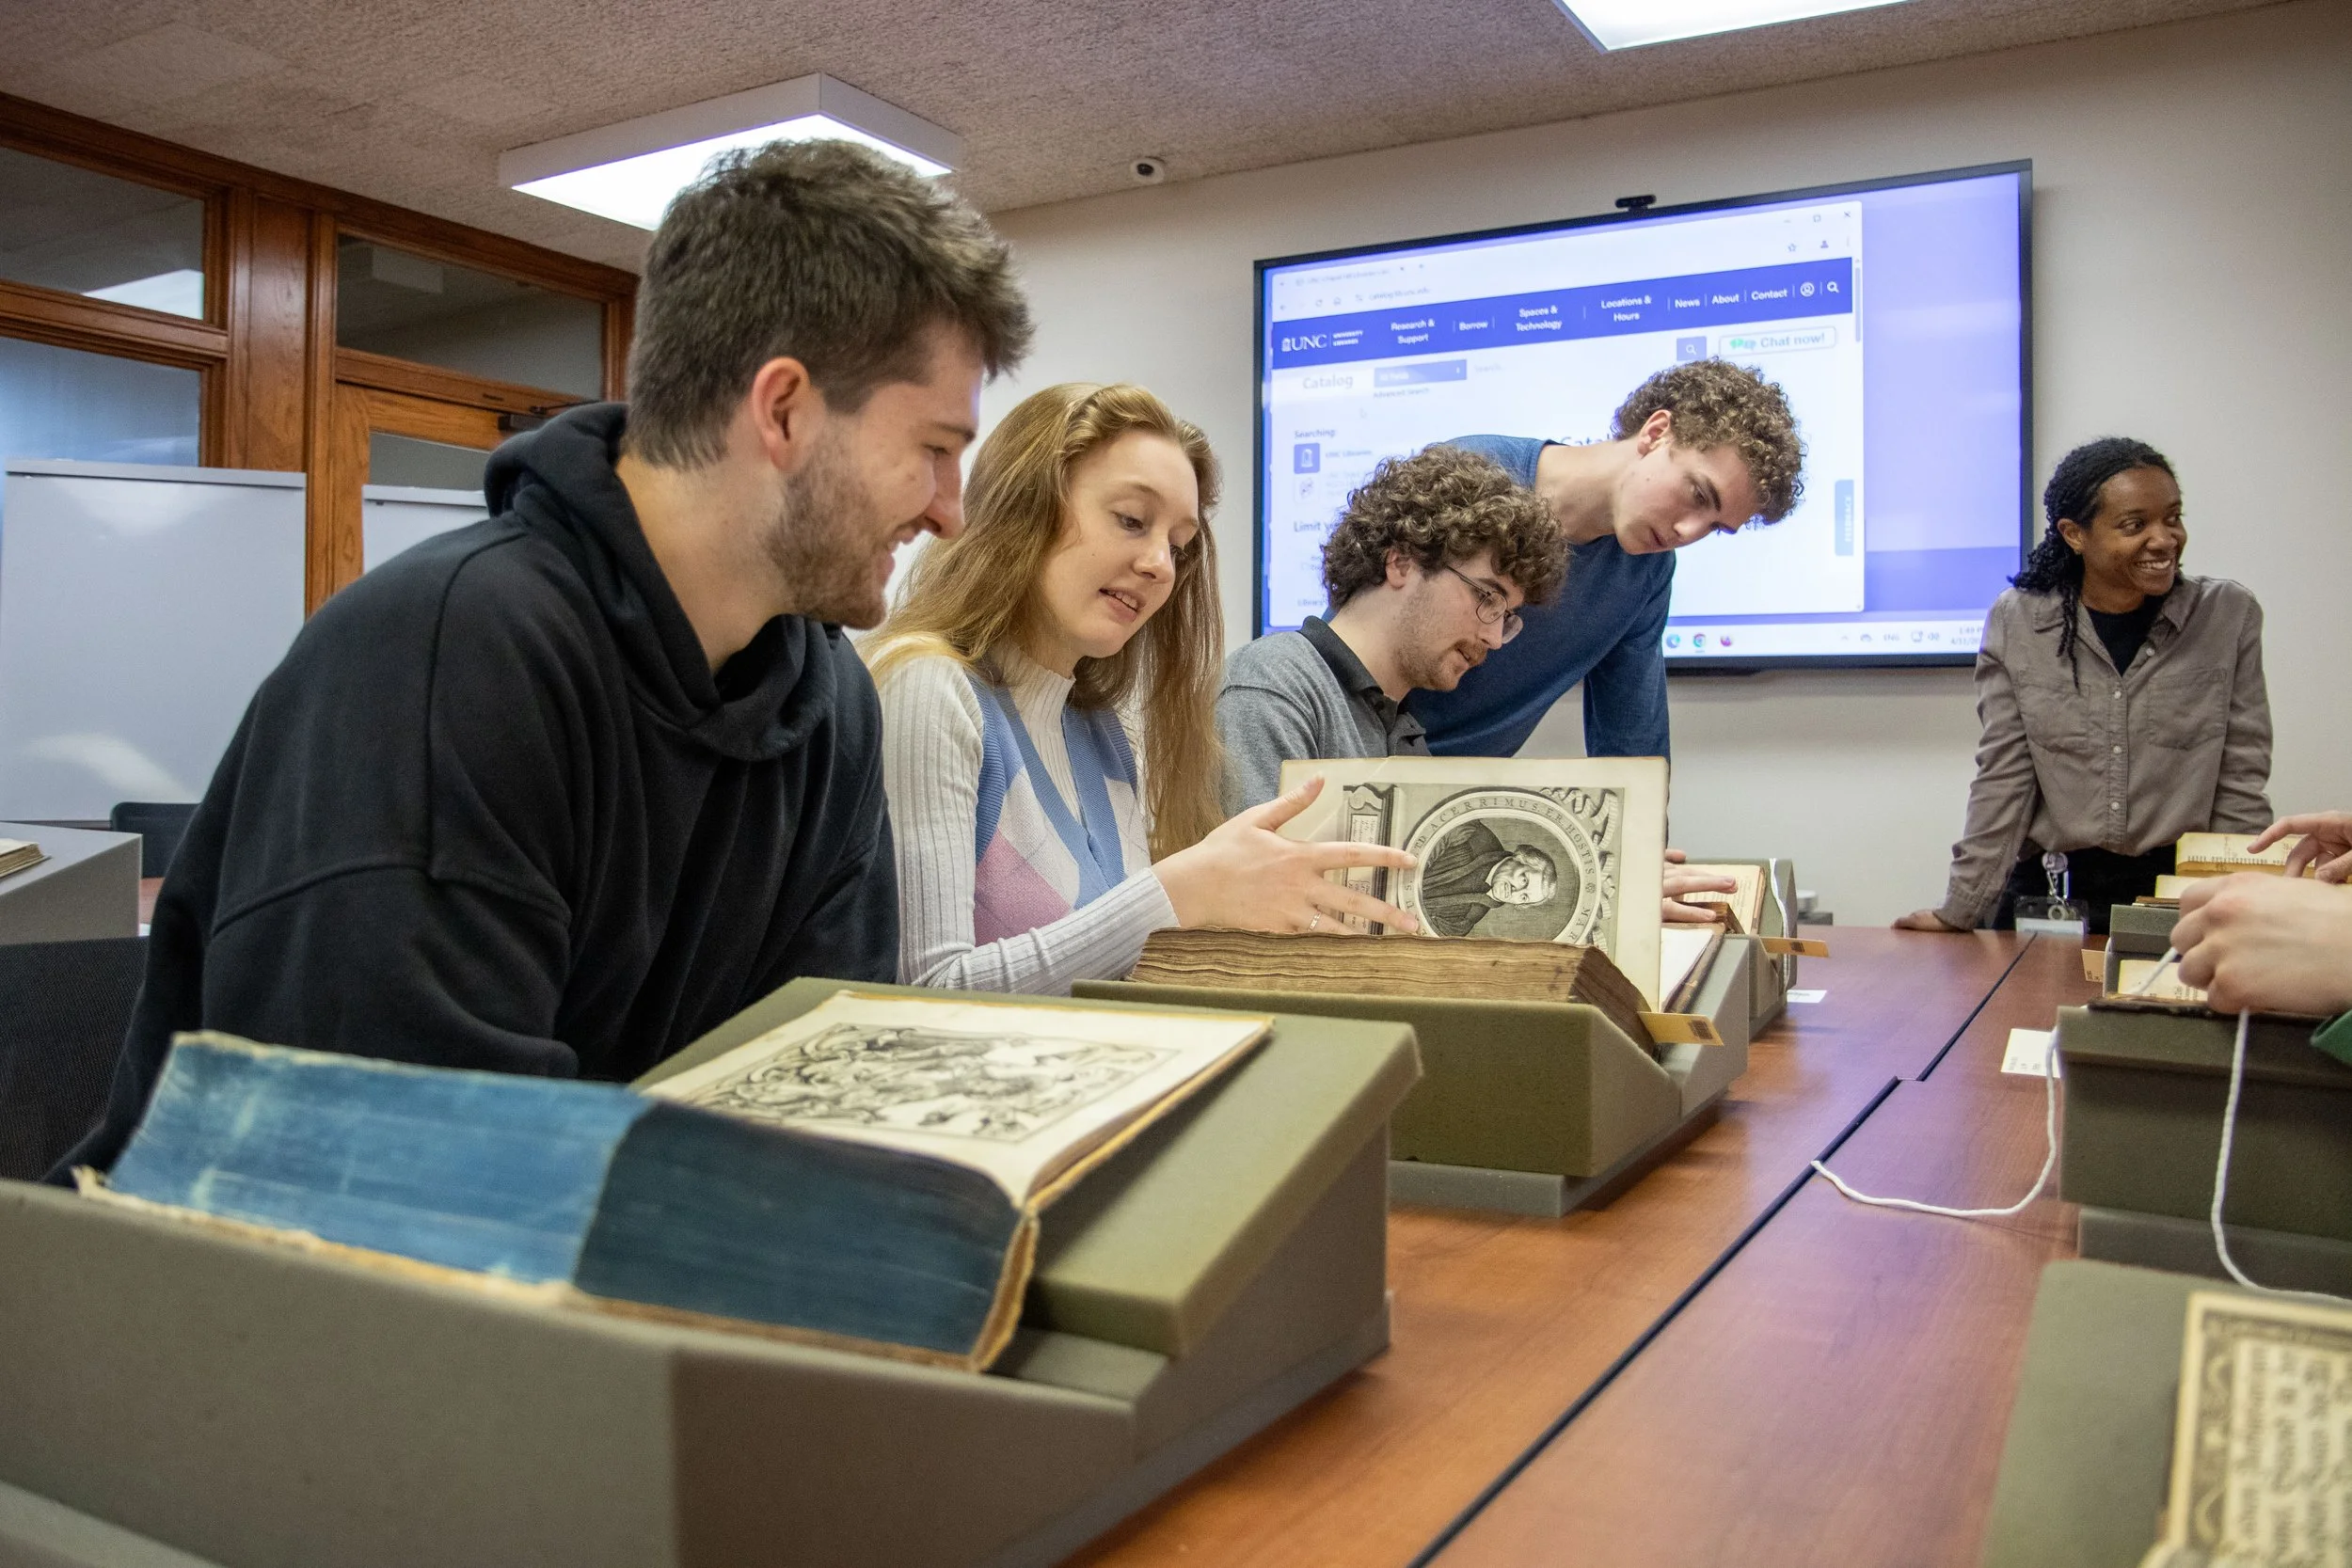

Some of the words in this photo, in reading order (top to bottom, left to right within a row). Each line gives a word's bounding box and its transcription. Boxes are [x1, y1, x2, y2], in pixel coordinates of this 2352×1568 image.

[1711, 294, 1740, 305] About
[1751, 289, 1788, 301] Contact
[1601, 296, 1643, 309] Locations
[1644, 294, 1651, 305] &
[1675, 298, 1700, 309] News
[1518, 307, 1549, 318] Spaces
[1550, 305, 1558, 314] &
[1613, 311, 1640, 322] Hours
[1391, 320, 1426, 332] Research
[1428, 318, 1436, 327] &
[1458, 321, 1489, 331] Borrow
[1515, 320, 1563, 331] Technology
[1292, 334, 1327, 352] UNC
[1397, 333, 1429, 344] Support
[1760, 335, 1790, 348] Chat
[1794, 333, 1825, 345] now!
[1303, 373, 1354, 389] Catalog
[1294, 520, 1321, 532] Limit
[1565, 824, 1595, 874] HOSTIS
